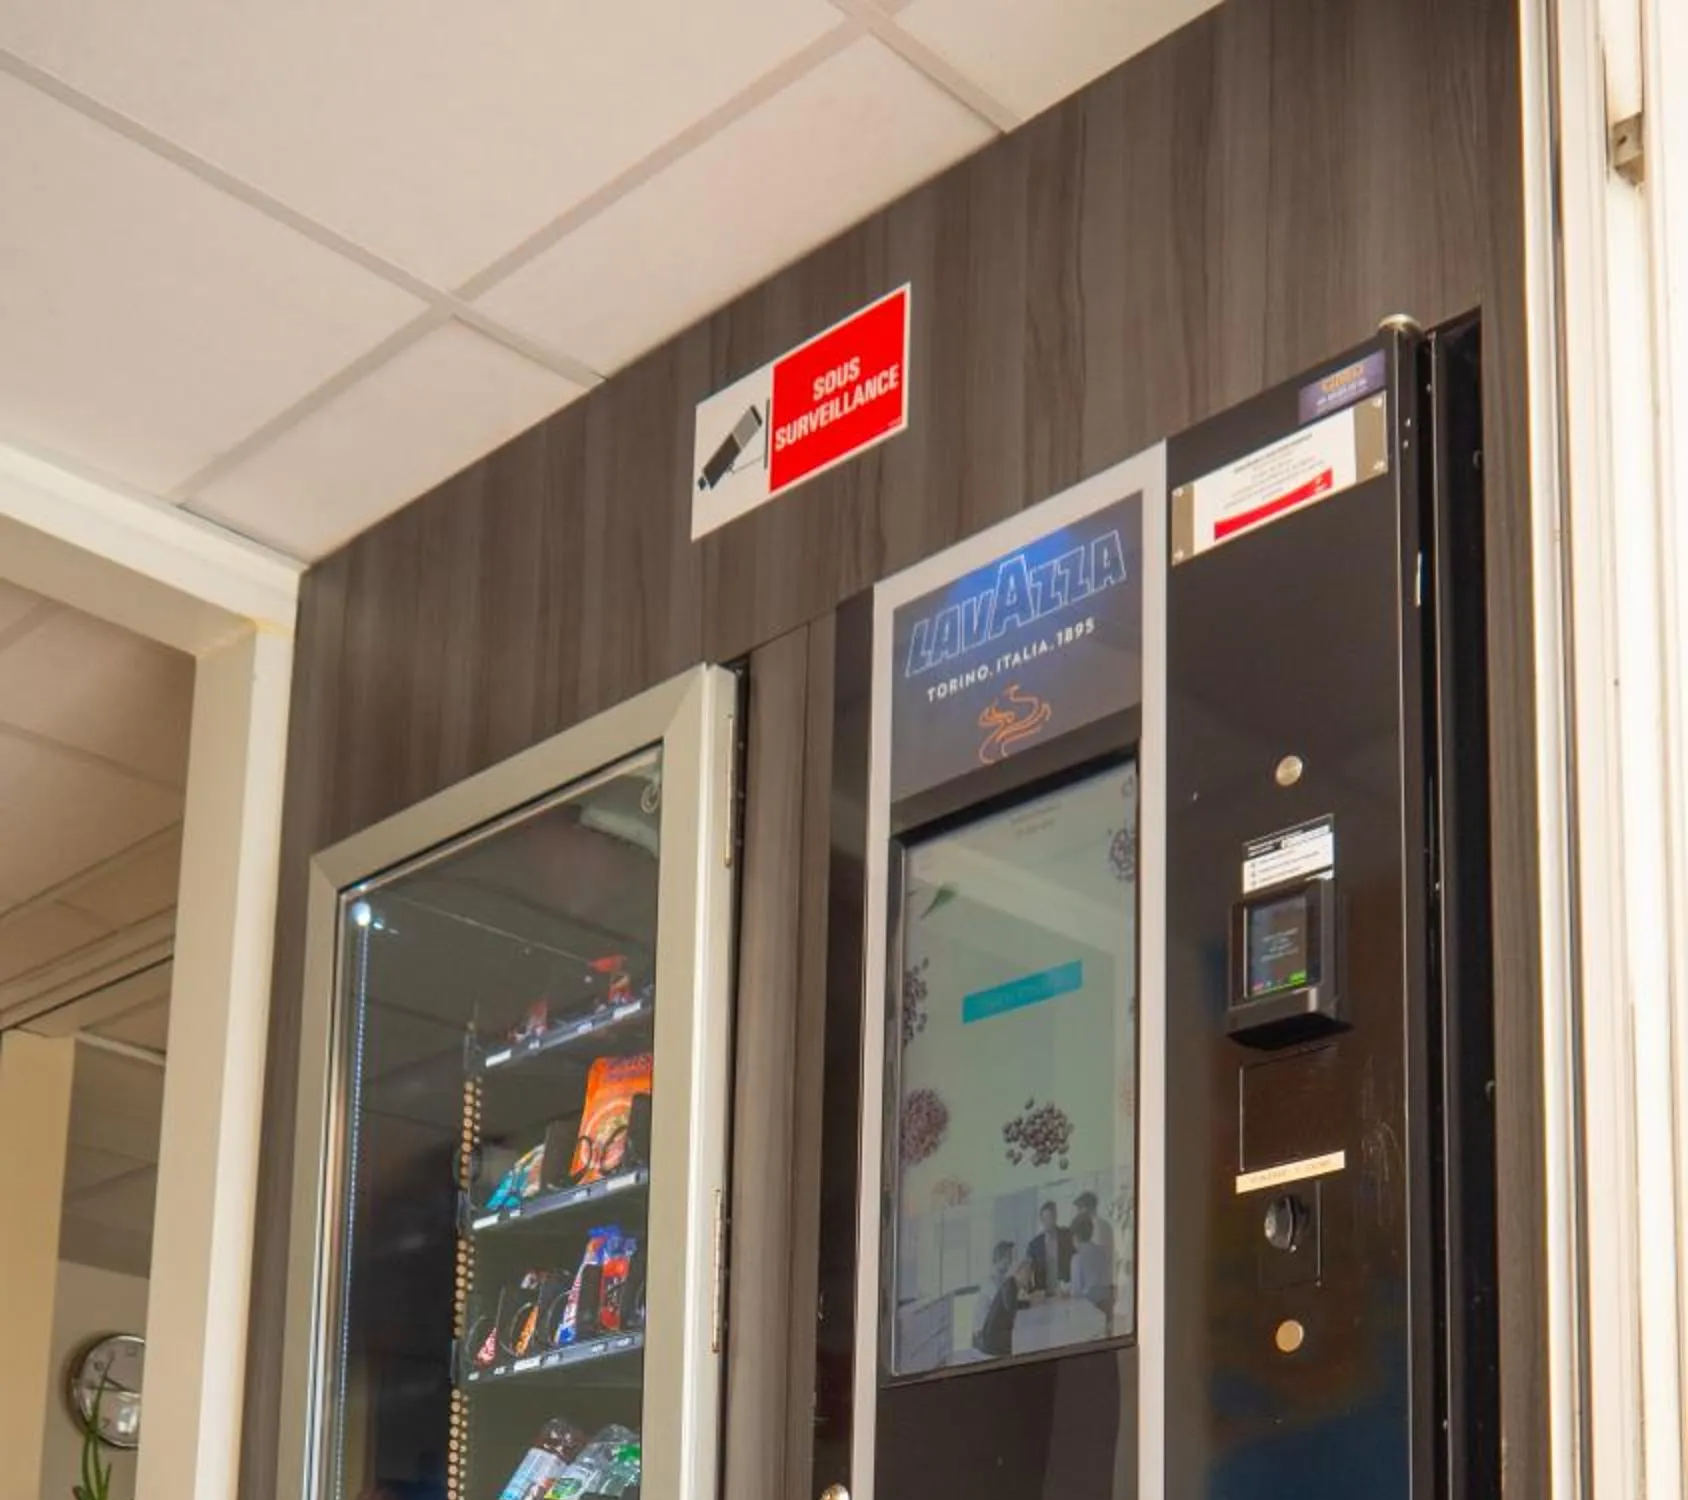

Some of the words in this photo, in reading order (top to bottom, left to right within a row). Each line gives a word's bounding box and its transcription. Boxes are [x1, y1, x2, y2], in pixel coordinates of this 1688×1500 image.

[775, 363, 899, 452] SURVEILLANCE
[813, 356, 861, 401] SOUS
[904, 529, 1128, 678] LAVAZZA
[1056, 617, 1095, 649] 1895
